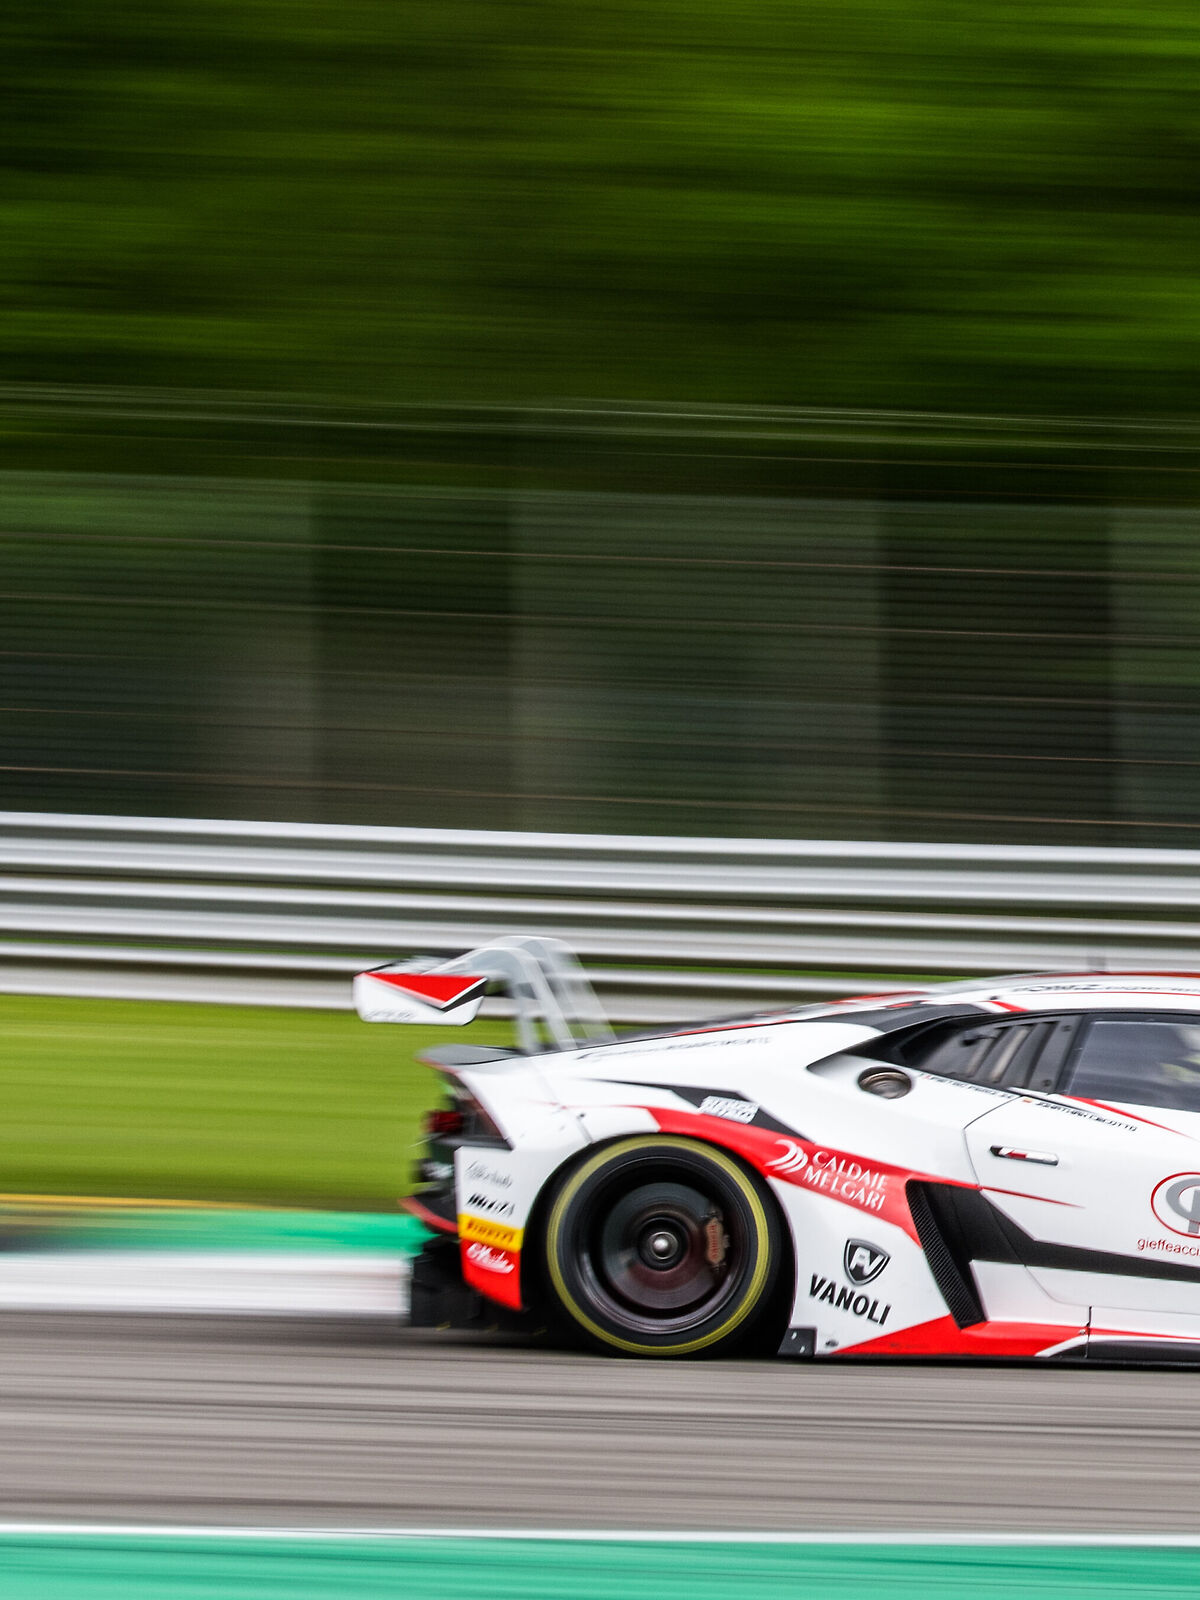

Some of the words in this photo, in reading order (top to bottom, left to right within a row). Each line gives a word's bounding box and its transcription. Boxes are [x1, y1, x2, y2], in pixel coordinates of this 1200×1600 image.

[803, 1165, 886, 1212] MELGARI
[812, 1151, 887, 1191] CALDAIE
[809, 1273, 892, 1326] VANOLI
